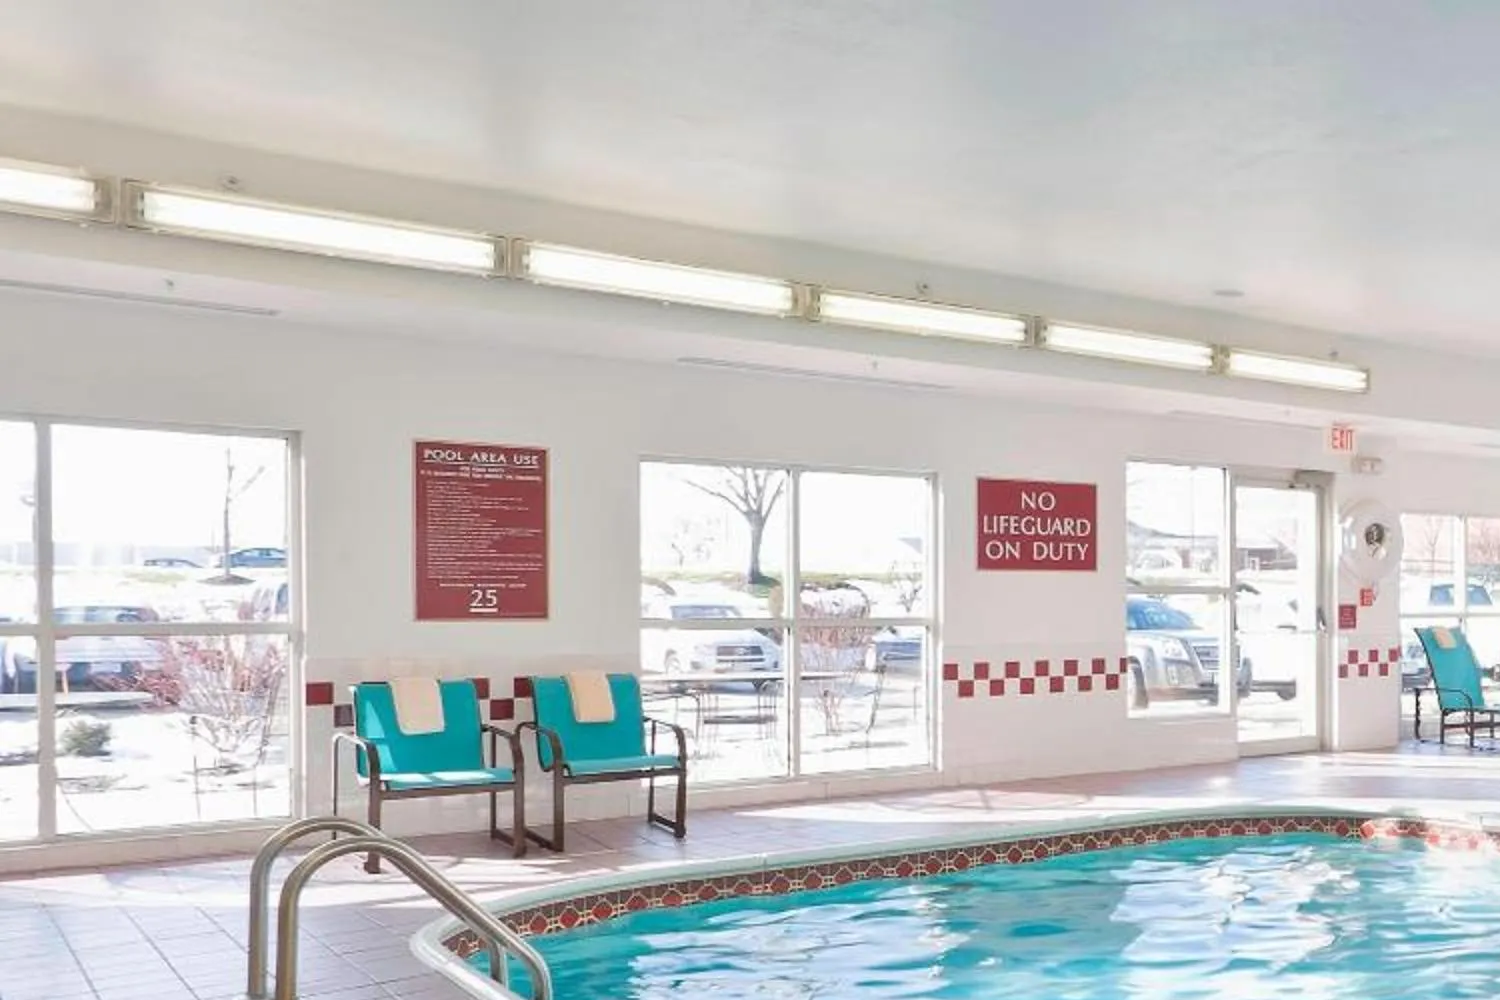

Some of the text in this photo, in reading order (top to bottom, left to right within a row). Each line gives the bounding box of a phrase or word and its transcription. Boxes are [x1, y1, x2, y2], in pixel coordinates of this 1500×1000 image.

[1331, 427, 1353, 451] EXIT
[423, 449, 539, 465] POOL AREA USE
[1021, 490, 1056, 511] NO
[983, 515, 1091, 537] LIFEGUARD
[985, 540, 1089, 561] ON DUTY
[469, 589, 497, 607] 25
